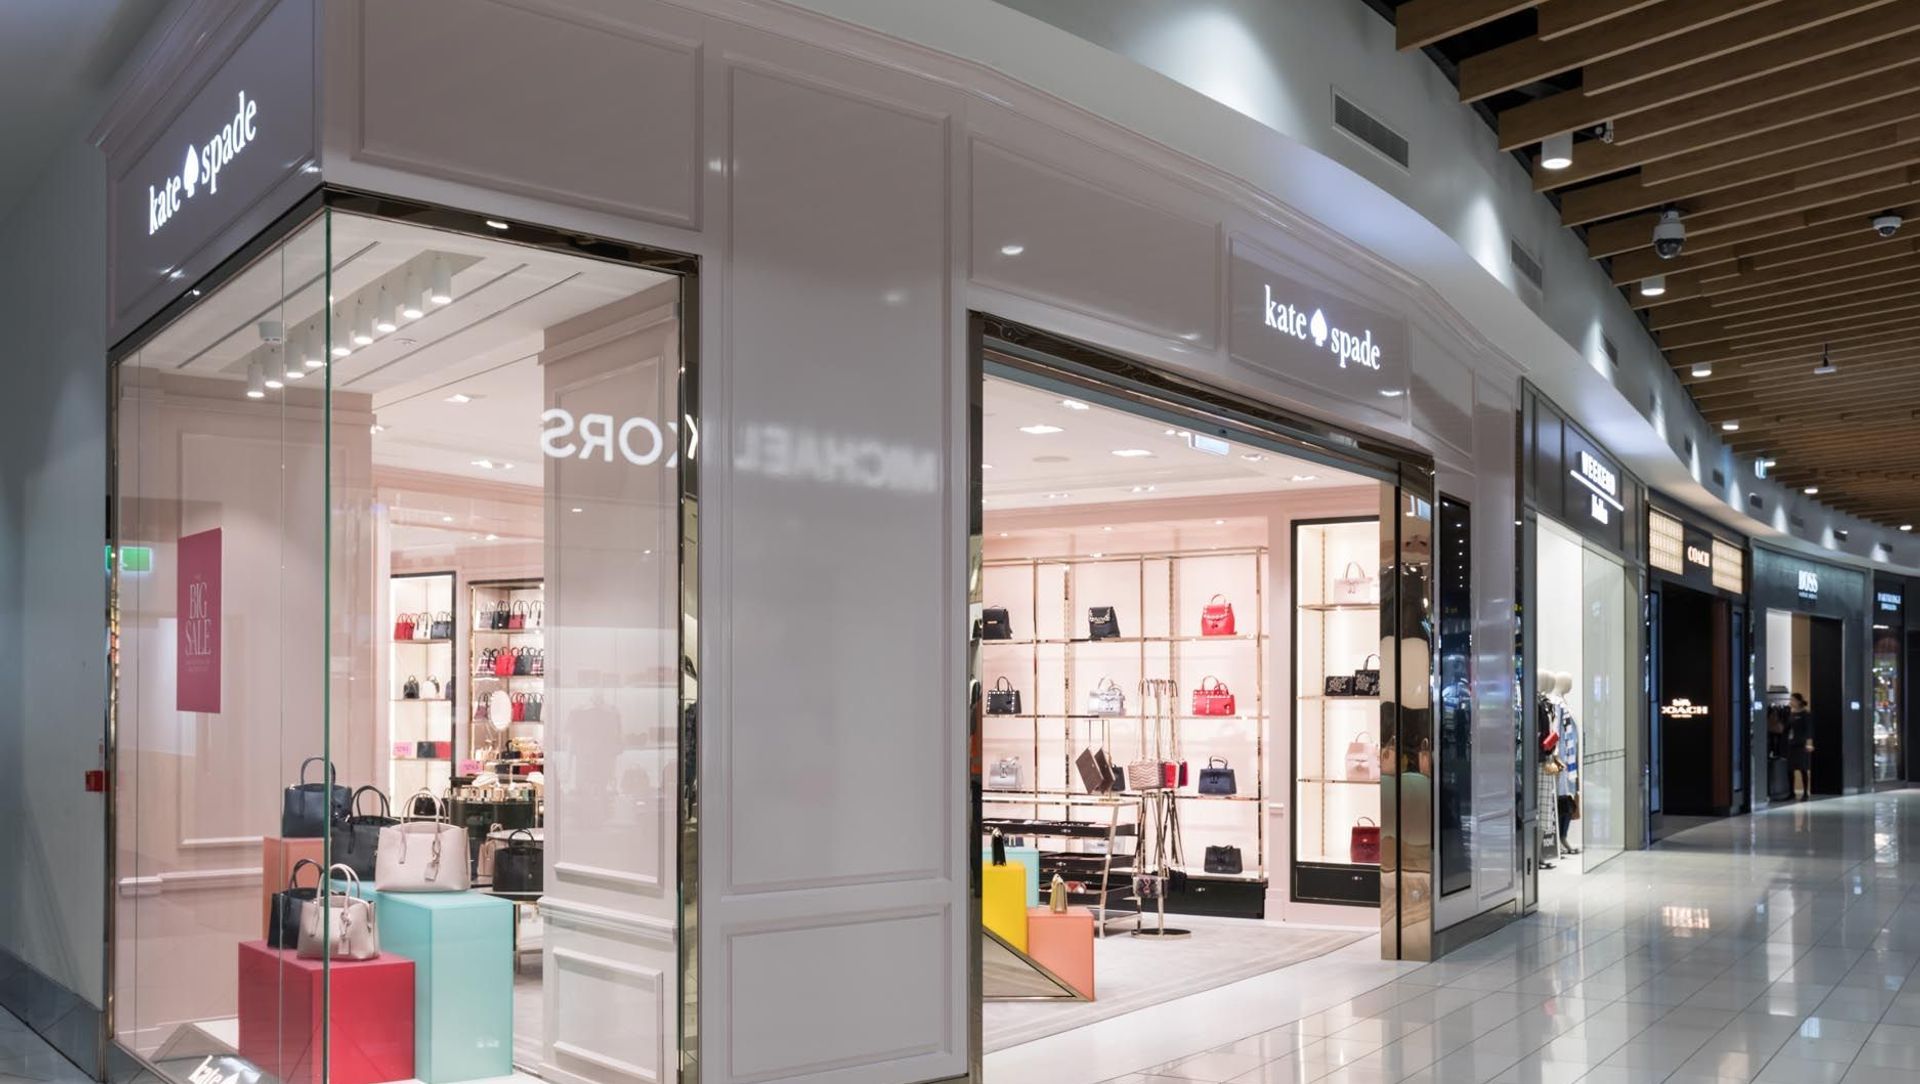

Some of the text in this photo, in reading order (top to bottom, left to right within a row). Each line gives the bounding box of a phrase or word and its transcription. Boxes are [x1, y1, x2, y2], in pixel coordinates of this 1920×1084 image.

[149, 90, 257, 235] kate spade
[1264, 284, 1381, 370] kate spade
[189, 582, 208, 620] BIG
[185, 619, 212, 656] SALE
